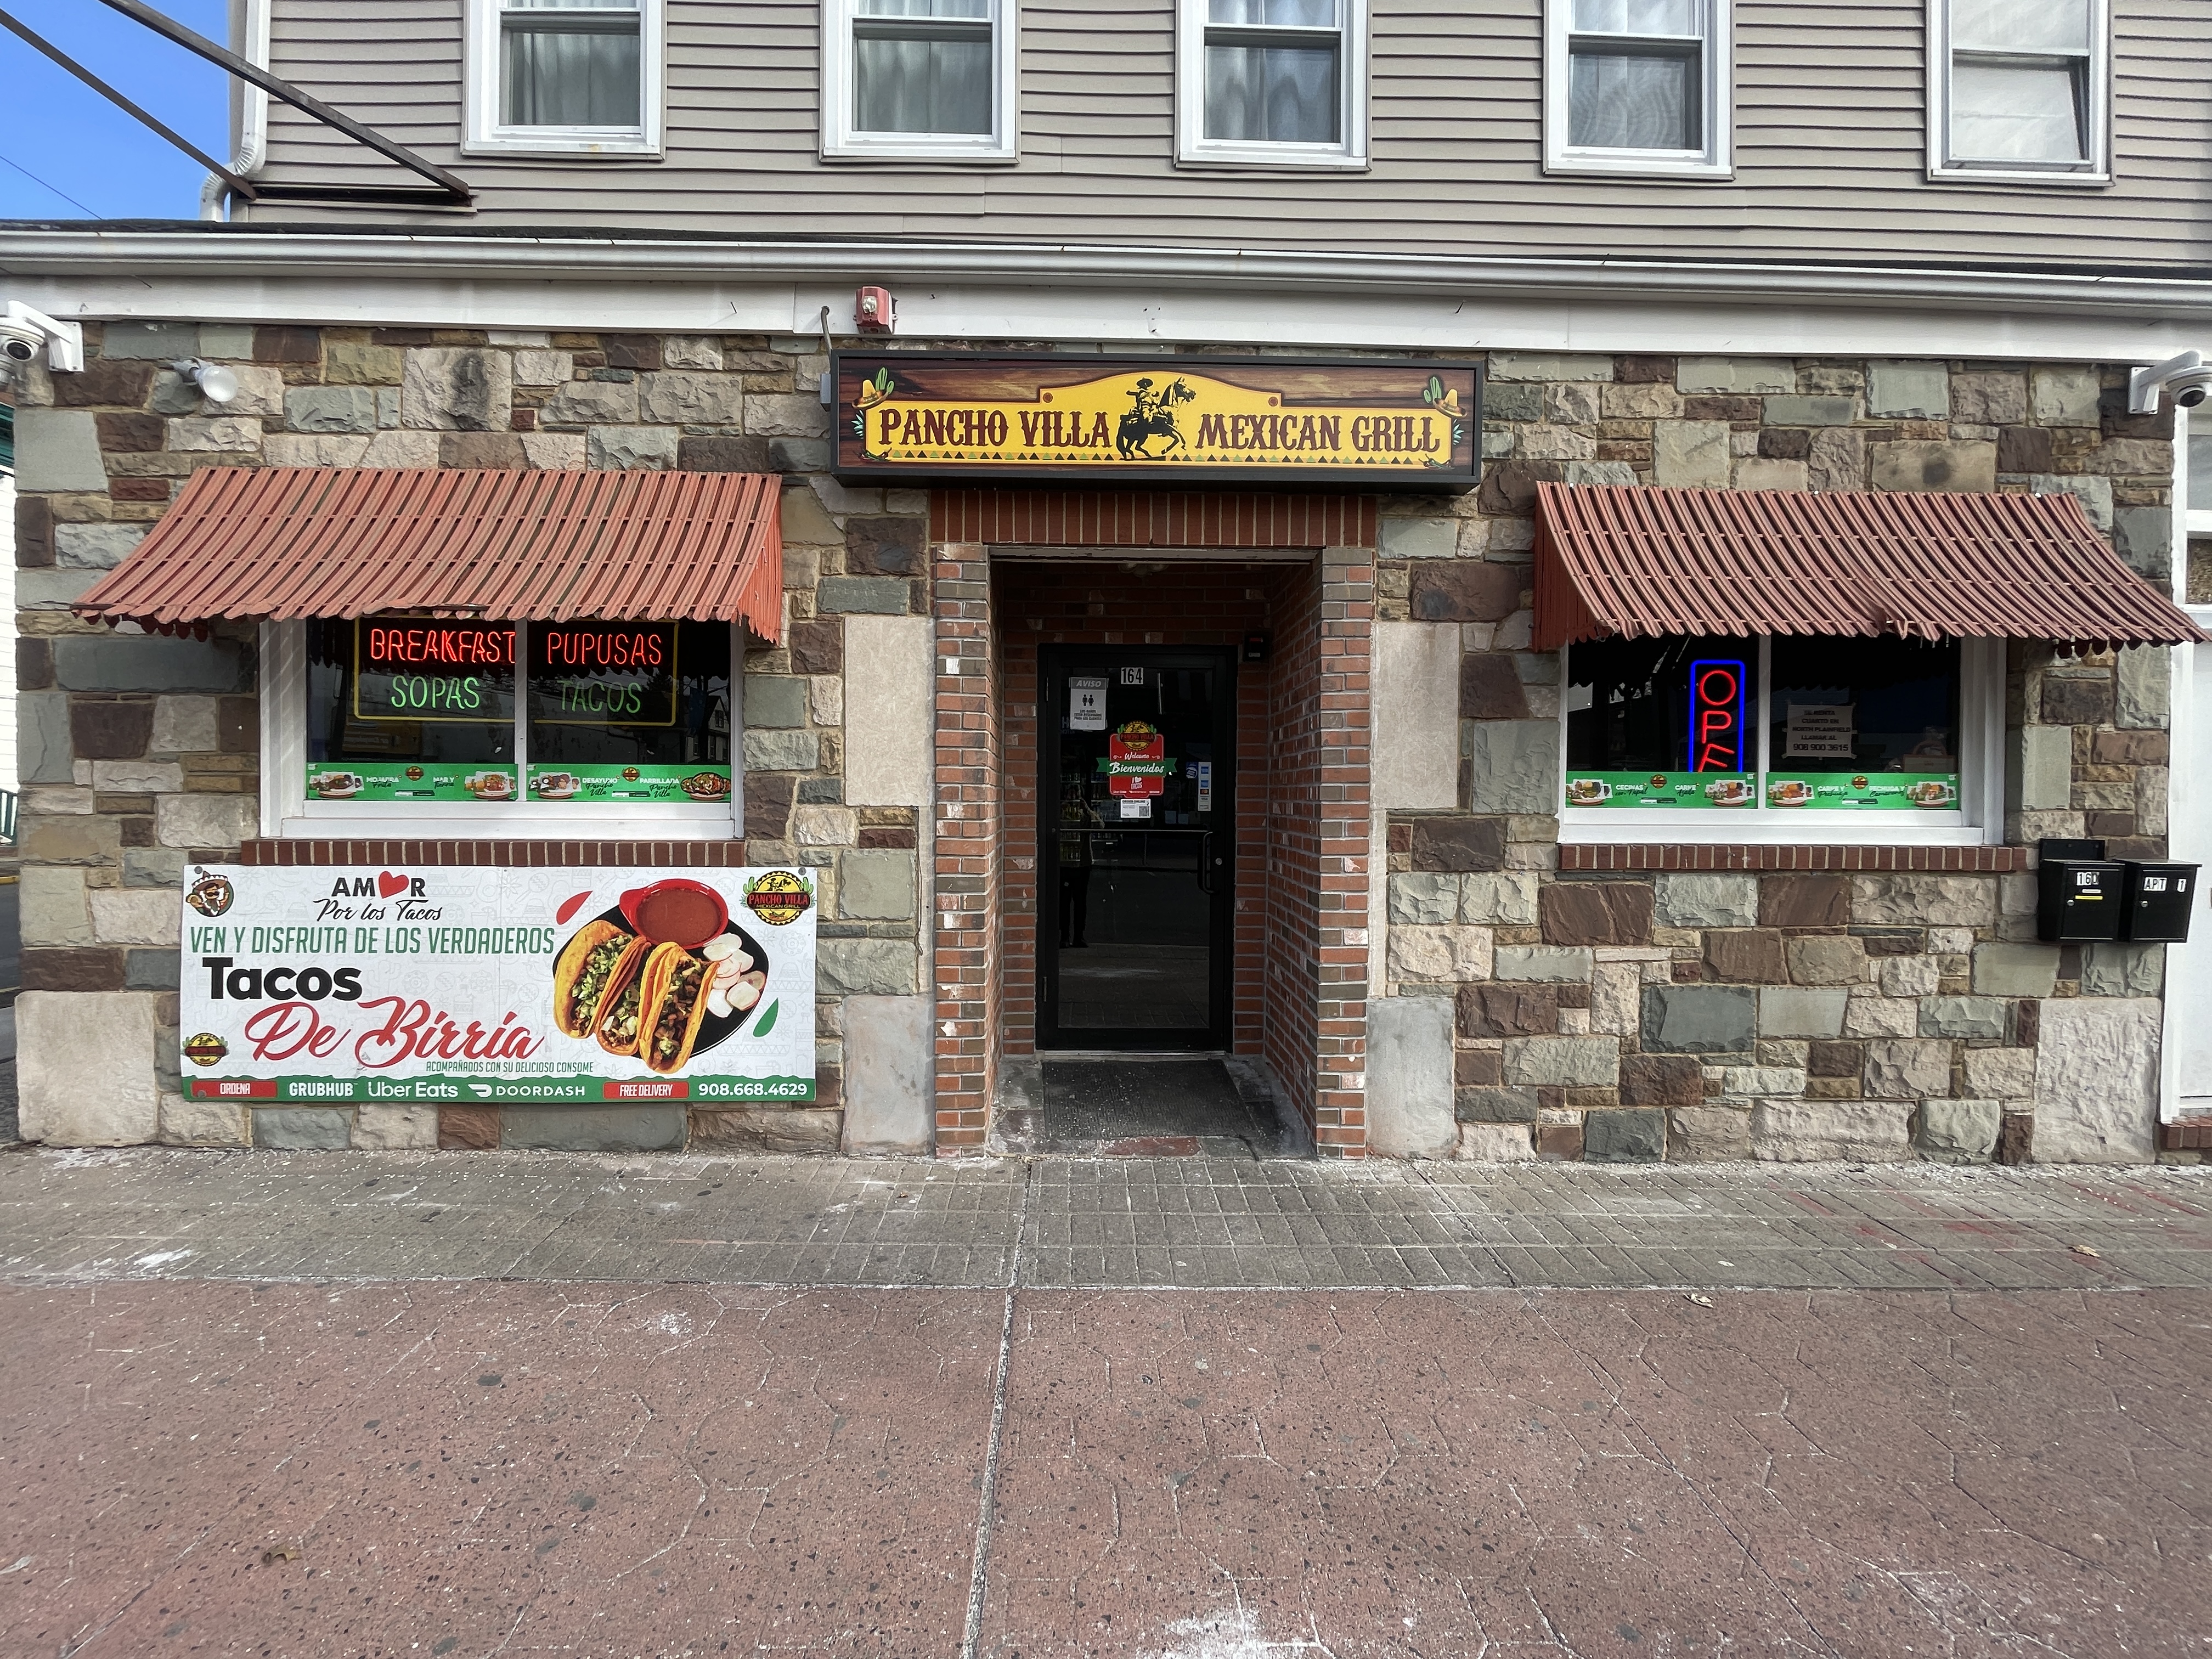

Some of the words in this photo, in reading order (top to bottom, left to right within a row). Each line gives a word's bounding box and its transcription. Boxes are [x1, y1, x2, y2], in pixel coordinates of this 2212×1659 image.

[878, 409, 1009, 447] PANCHO
[1017, 410, 1113, 448] VILLA
[1194, 413, 1342, 450] MEXICAN
[1351, 415, 1441, 453] GRILL
[370, 629, 516, 663] BREAKFAST
[548, 632, 663, 665] PUPUSAS
[1122, 668, 1142, 684] 164
[391, 676, 481, 710] SOPAS
[556, 679, 643, 714] TACOS
[1697, 669, 1738, 772] OPE
[1109, 761, 1165, 774] Bienvenidos
[2145, 878, 2166, 890] APT
[748, 894, 782, 905] PANCHO
[784, 894, 809, 905] VILLA
[313, 898, 358, 922] Por
[360, 903, 387, 921] los
[395, 899, 443, 921] Tacos
[190, 926, 227, 953] VEN
[234, 926, 246, 953] Y
[251, 926, 348, 954] DISFRUTA
[354, 927, 379, 954] DE
[385, 927, 421, 954] LOS
[427, 927, 555, 955] VERDADEROS
[202, 957, 363, 1001] Tacos
[245, 1001, 352, 1062] De
[426, 1061, 483, 1073] ACOMPAÑADOS
[485, 1062, 501, 1073] CON
[503, 1062, 514, 1073] SU
[515, 1062, 555, 1073] DELICIOSO
[556, 1062, 594, 1073] CONSOME
[219, 1082, 251, 1095] ORDENA
[289, 1082, 354, 1097] GRUBHUB
[368, 1081, 412, 1097] Uber
[415, 1081, 459, 1097] Eats
[496, 1085, 586, 1097] DOORDASH
[619, 1084, 638, 1097] FREE
[639, 1084, 673, 1097] DELIVERY
[698, 1082, 808, 1096] 908.668.4629
